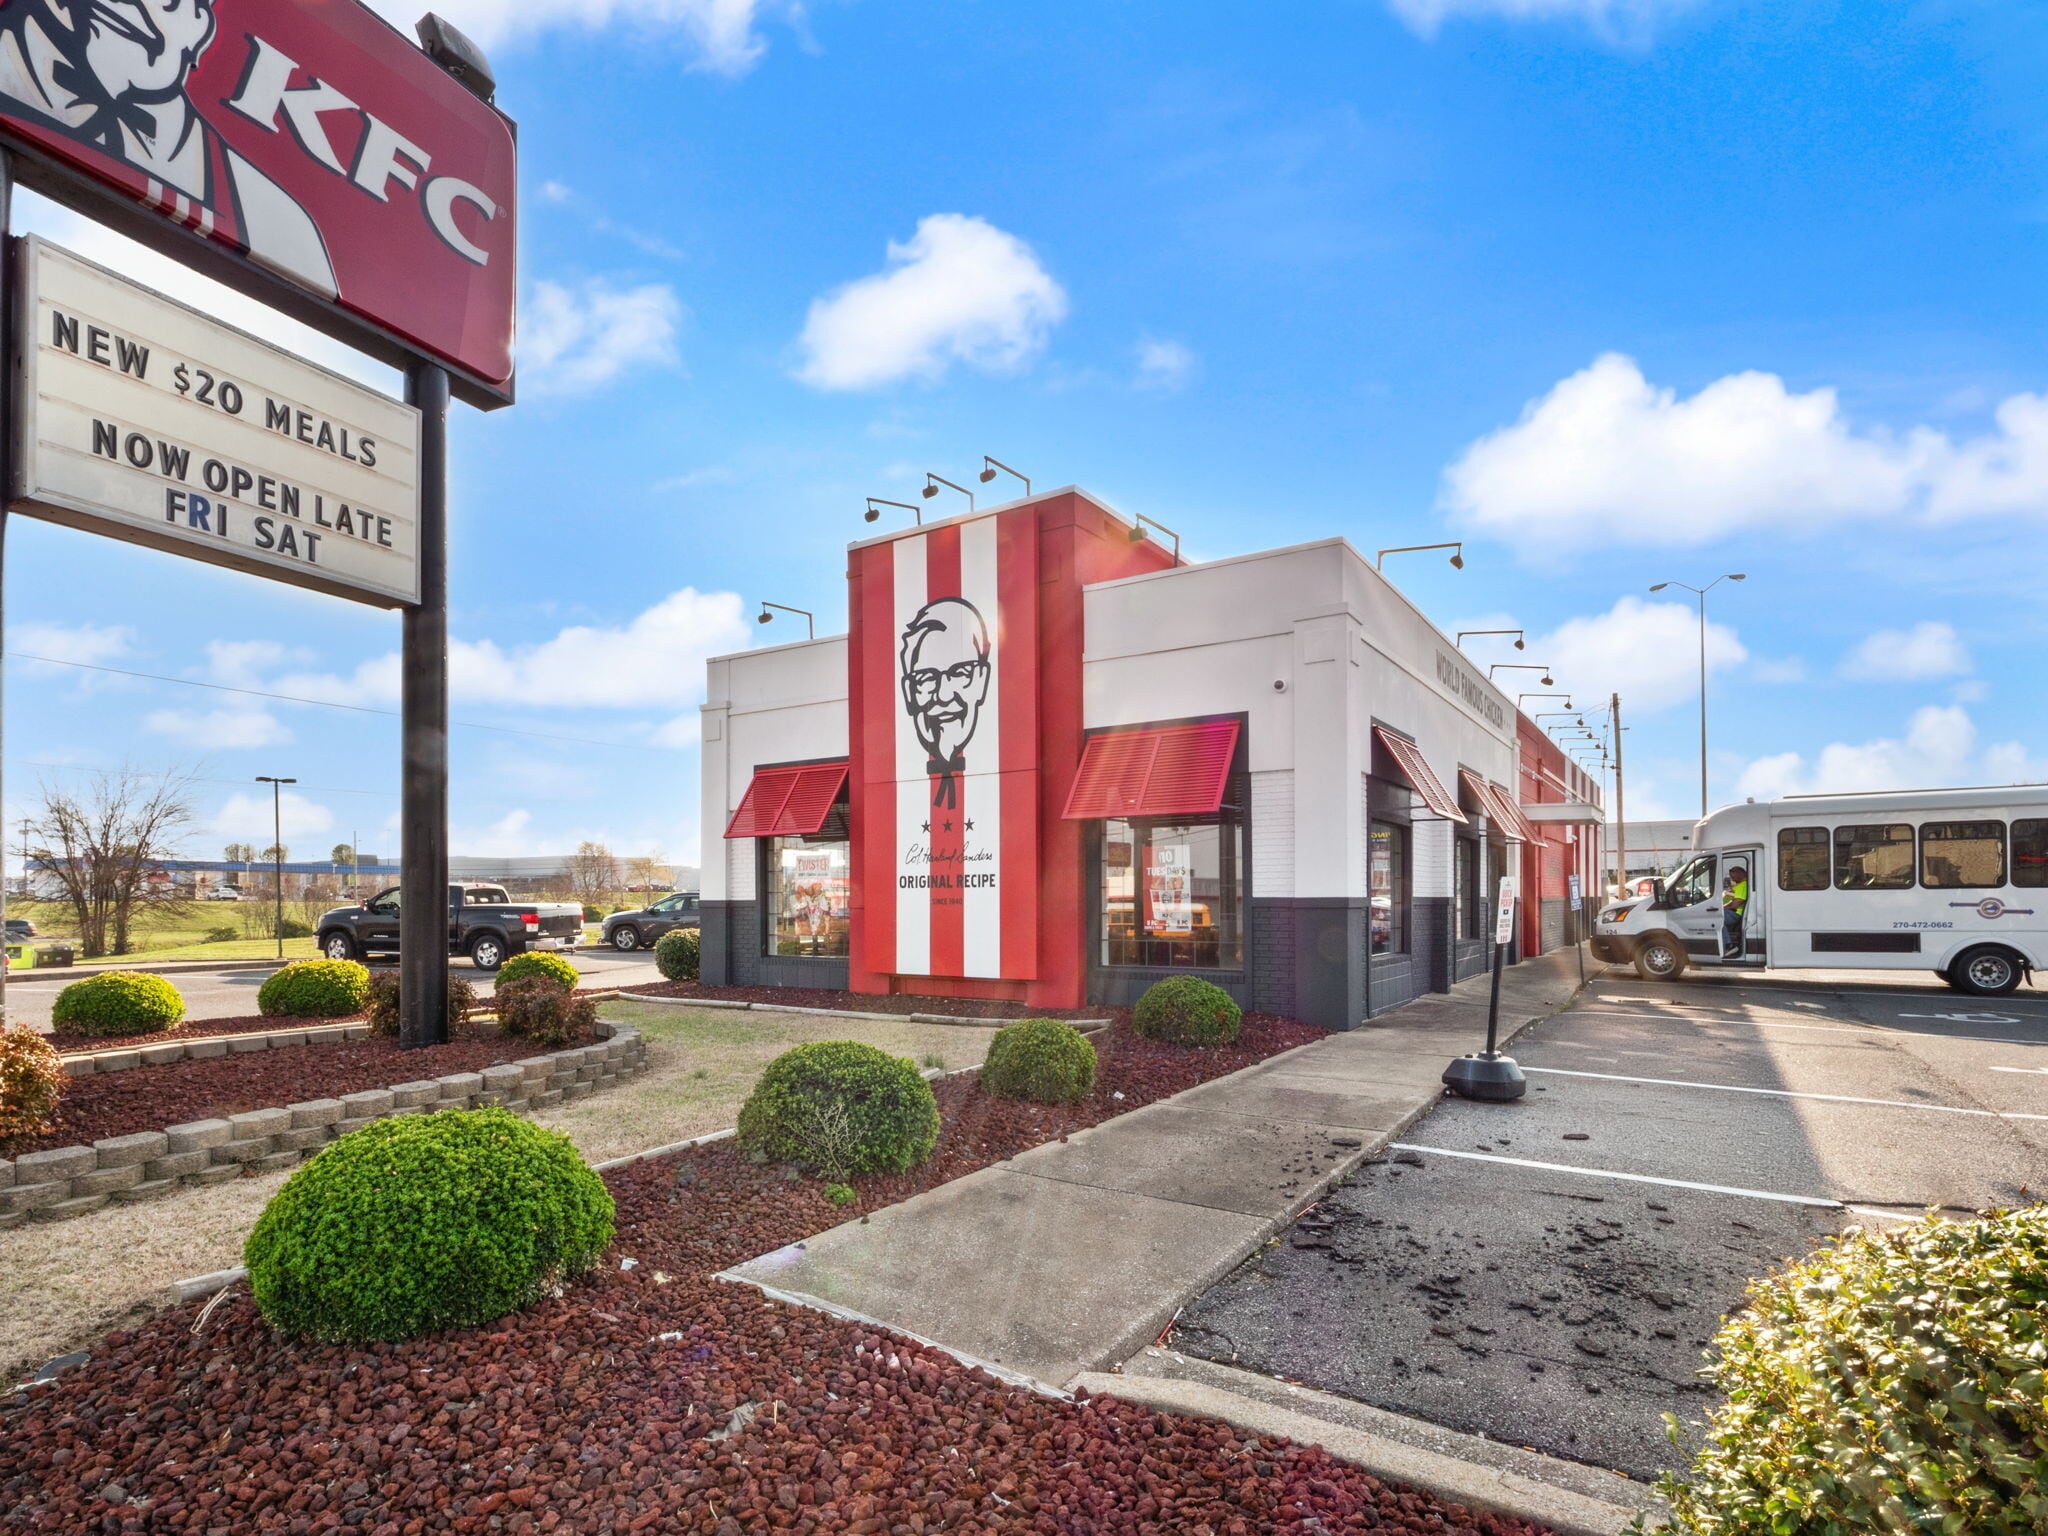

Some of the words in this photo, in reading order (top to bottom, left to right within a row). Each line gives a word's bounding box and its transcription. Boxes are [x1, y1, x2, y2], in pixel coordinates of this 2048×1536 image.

[225, 34, 496, 267] KFC
[52, 310, 150, 379] NEW
[173, 362, 243, 414] $20
[265, 397, 376, 467] MEALS
[92, 419, 190, 481] NOW
[202, 457, 300, 517] OPEN
[315, 495, 392, 548] LATE
[166, 488, 227, 536] FRI
[254, 515, 321, 562] SAT
[1435, 648, 1460, 695] WORLD
[1461, 672, 1483, 715] FAMOUS
[899, 875, 953, 888] ORIGINAL
[956, 874, 996, 888] RECIPE
